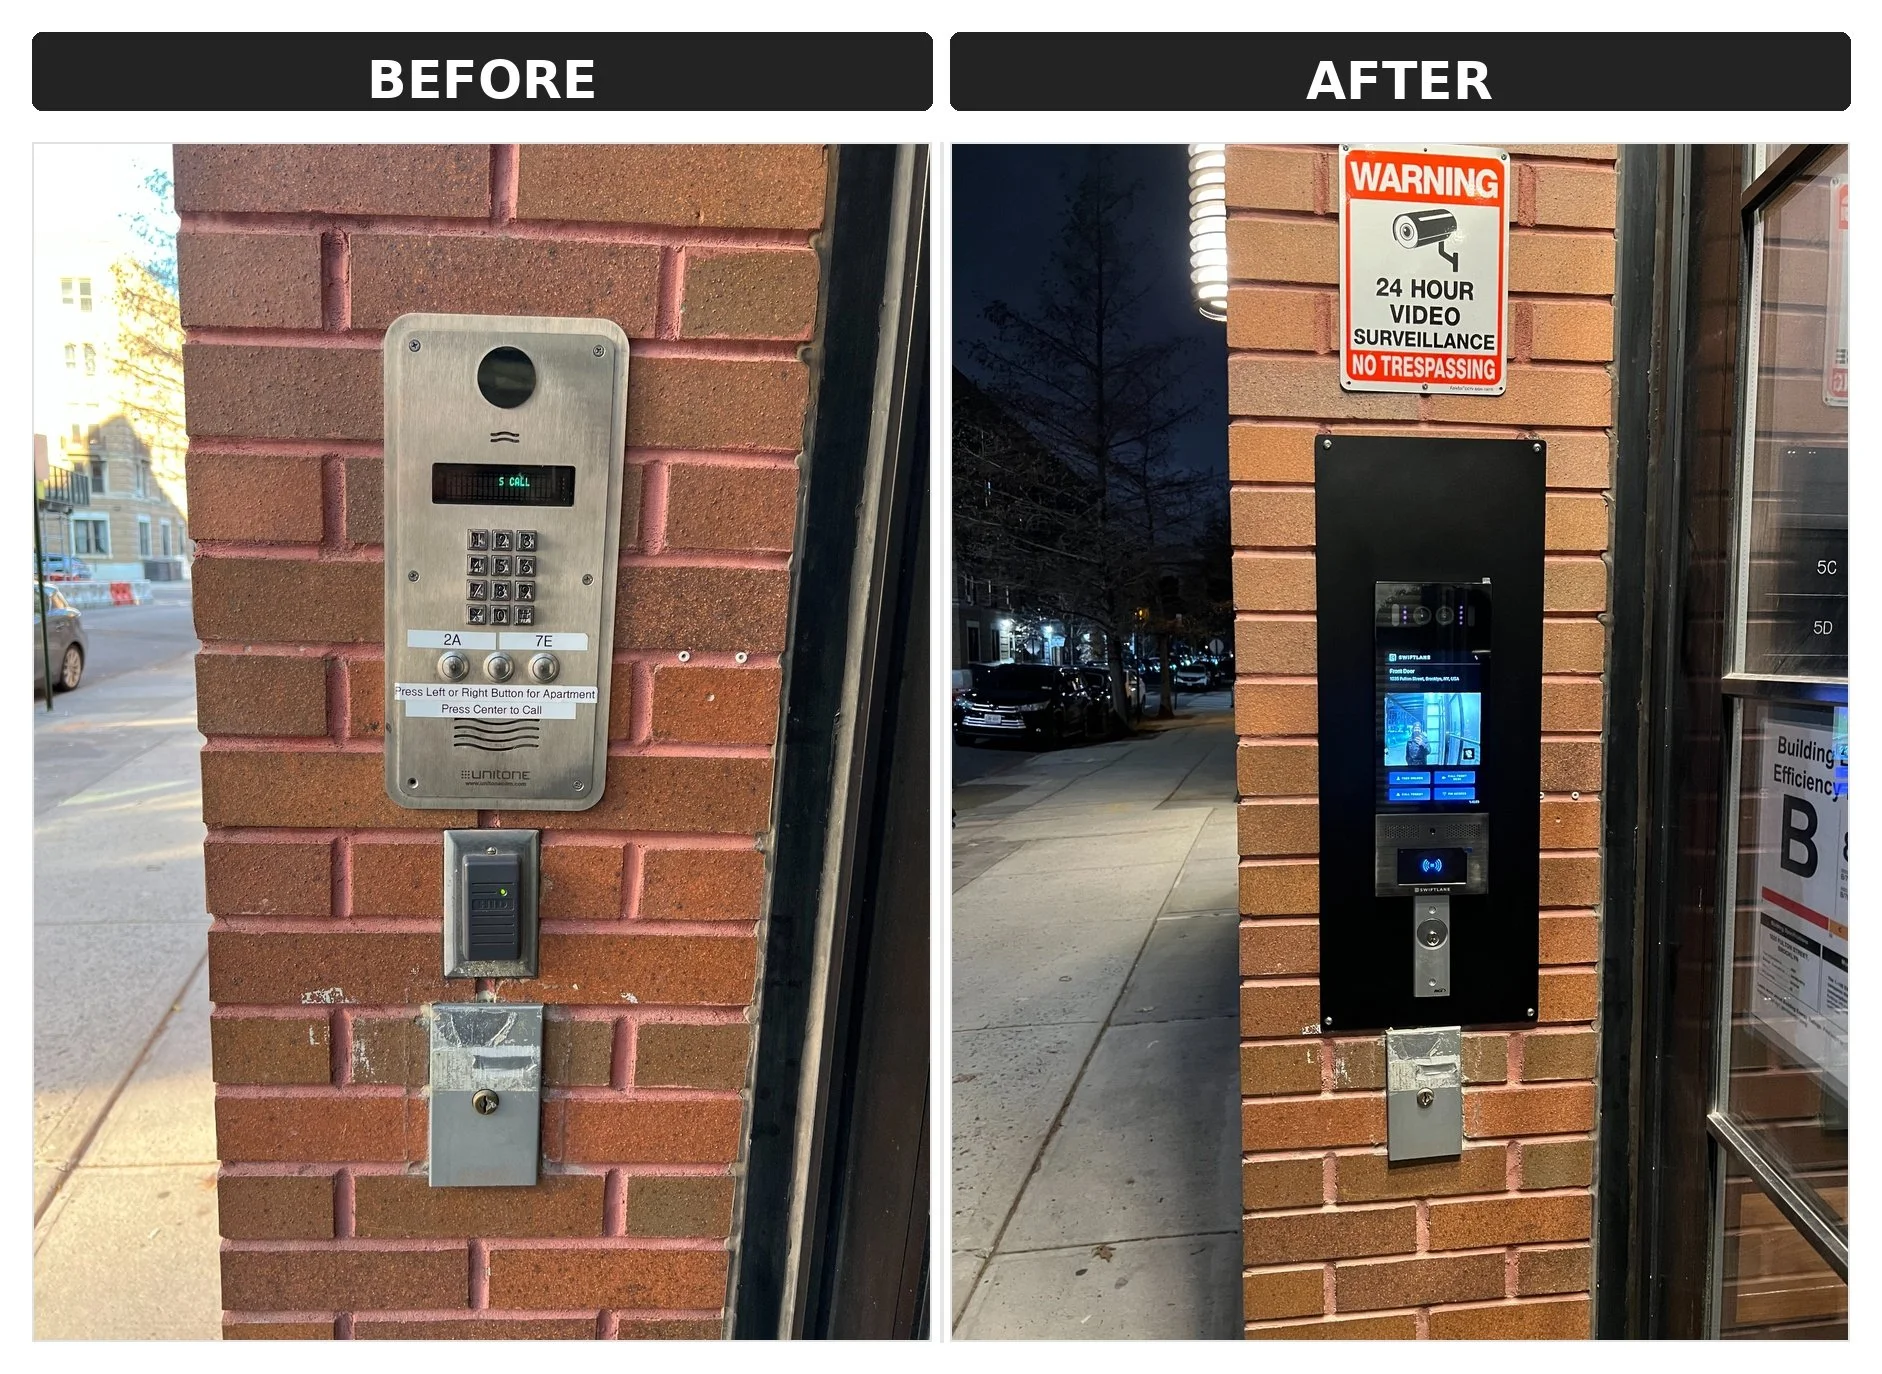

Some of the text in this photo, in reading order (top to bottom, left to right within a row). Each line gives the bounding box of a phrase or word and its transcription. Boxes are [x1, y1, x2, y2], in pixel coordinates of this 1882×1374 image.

[1350, 161, 1498, 199] WARNING
[1376, 277, 1474, 301] 24 HOUR
[1389, 303, 1460, 326] VIDEO
[1353, 328, 1495, 350] SURVEILLANCE
[1352, 353, 1496, 380] NO TRESPASSING
[498, 475, 530, 487] S CALL
[1817, 560, 1837, 575] 5C
[1813, 620, 1833, 635] 5D
[443, 633, 462, 646] 2A
[535, 634, 553, 647] 7E
[426, 687, 446, 697] Left
[448, 689, 459, 698] or
[461, 688, 488, 700] Right
[491, 688, 523, 699] Button
[526, 688, 540, 698] for
[543, 689, 596, 701] Apartment
[441, 704, 542, 715] Press Center to Call
[1777, 735, 1834, 769] Building
[1773, 764, 1842, 802] Efficiency
[1780, 793, 1818, 879] B
